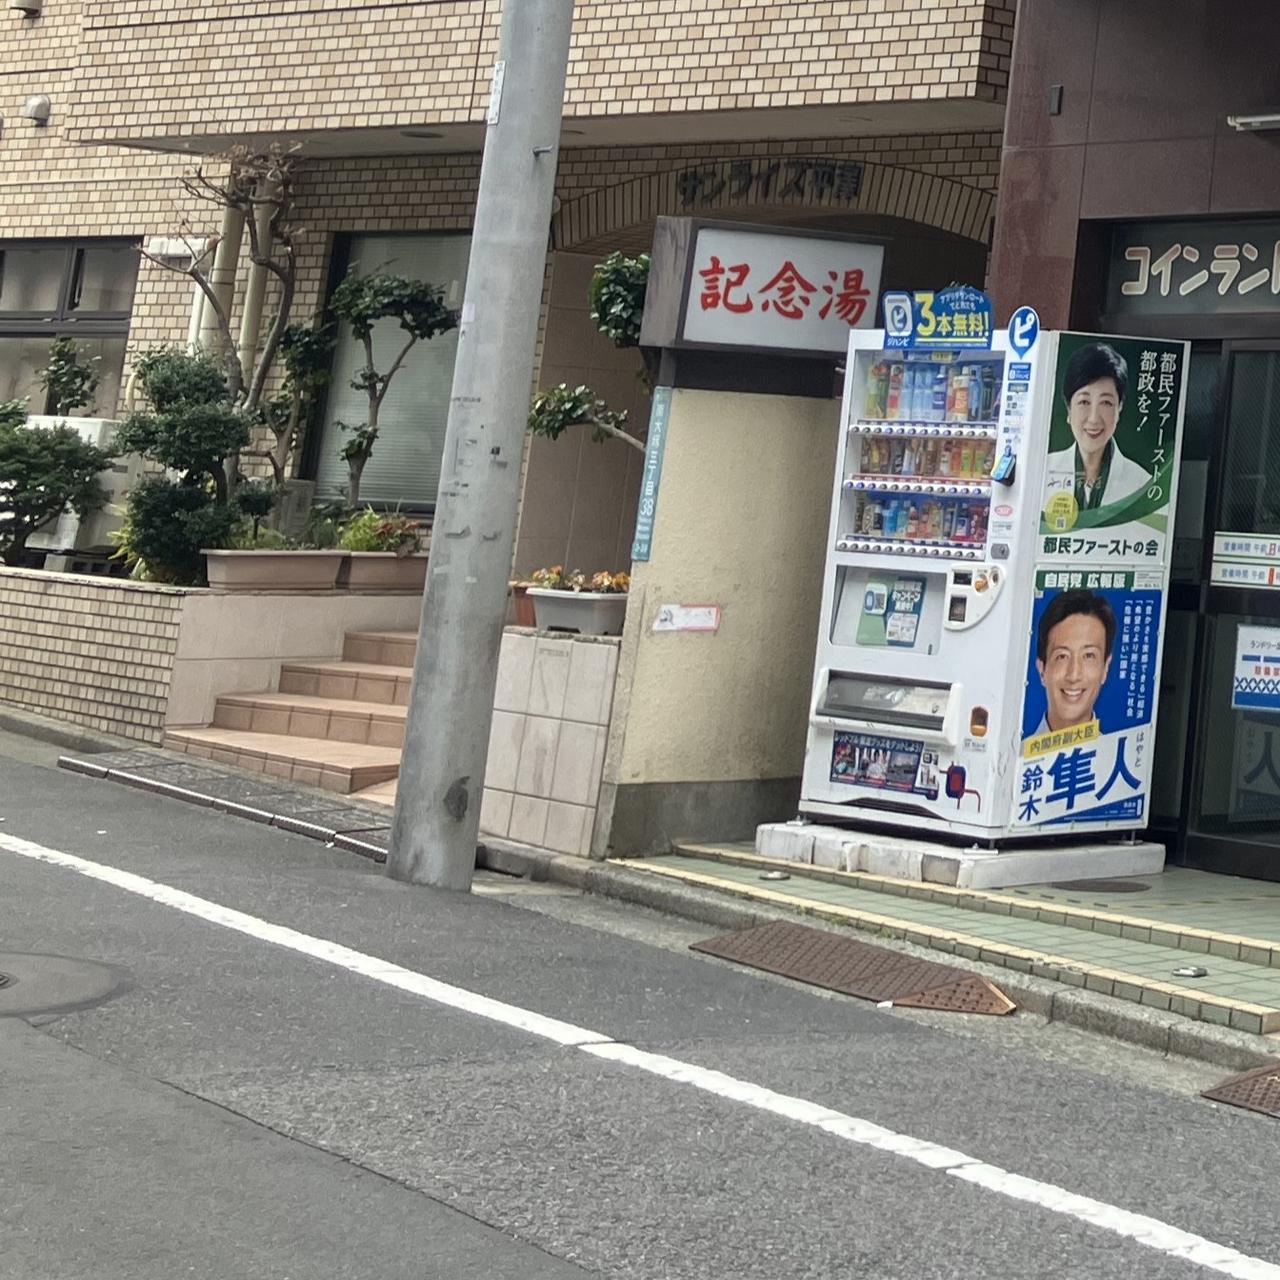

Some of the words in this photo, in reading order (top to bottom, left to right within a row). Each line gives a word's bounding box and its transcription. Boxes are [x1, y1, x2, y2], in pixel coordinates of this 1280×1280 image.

[699, 255, 871, 326] 記念湯
[1013, 312, 1035, 348] ピ
[1146, 351, 1177, 502] 都民ファーストの
[1043, 536, 1159, 557] 都民ファーストの会
[1044, 572, 1082, 591] 自民党
[1030, 724, 1095, 754] 内閣府副大臣
[1134, 732, 1145, 768] はやと
[1045, 736, 1142, 811] 隼人
[1018, 764, 1044, 822] 鈴木
